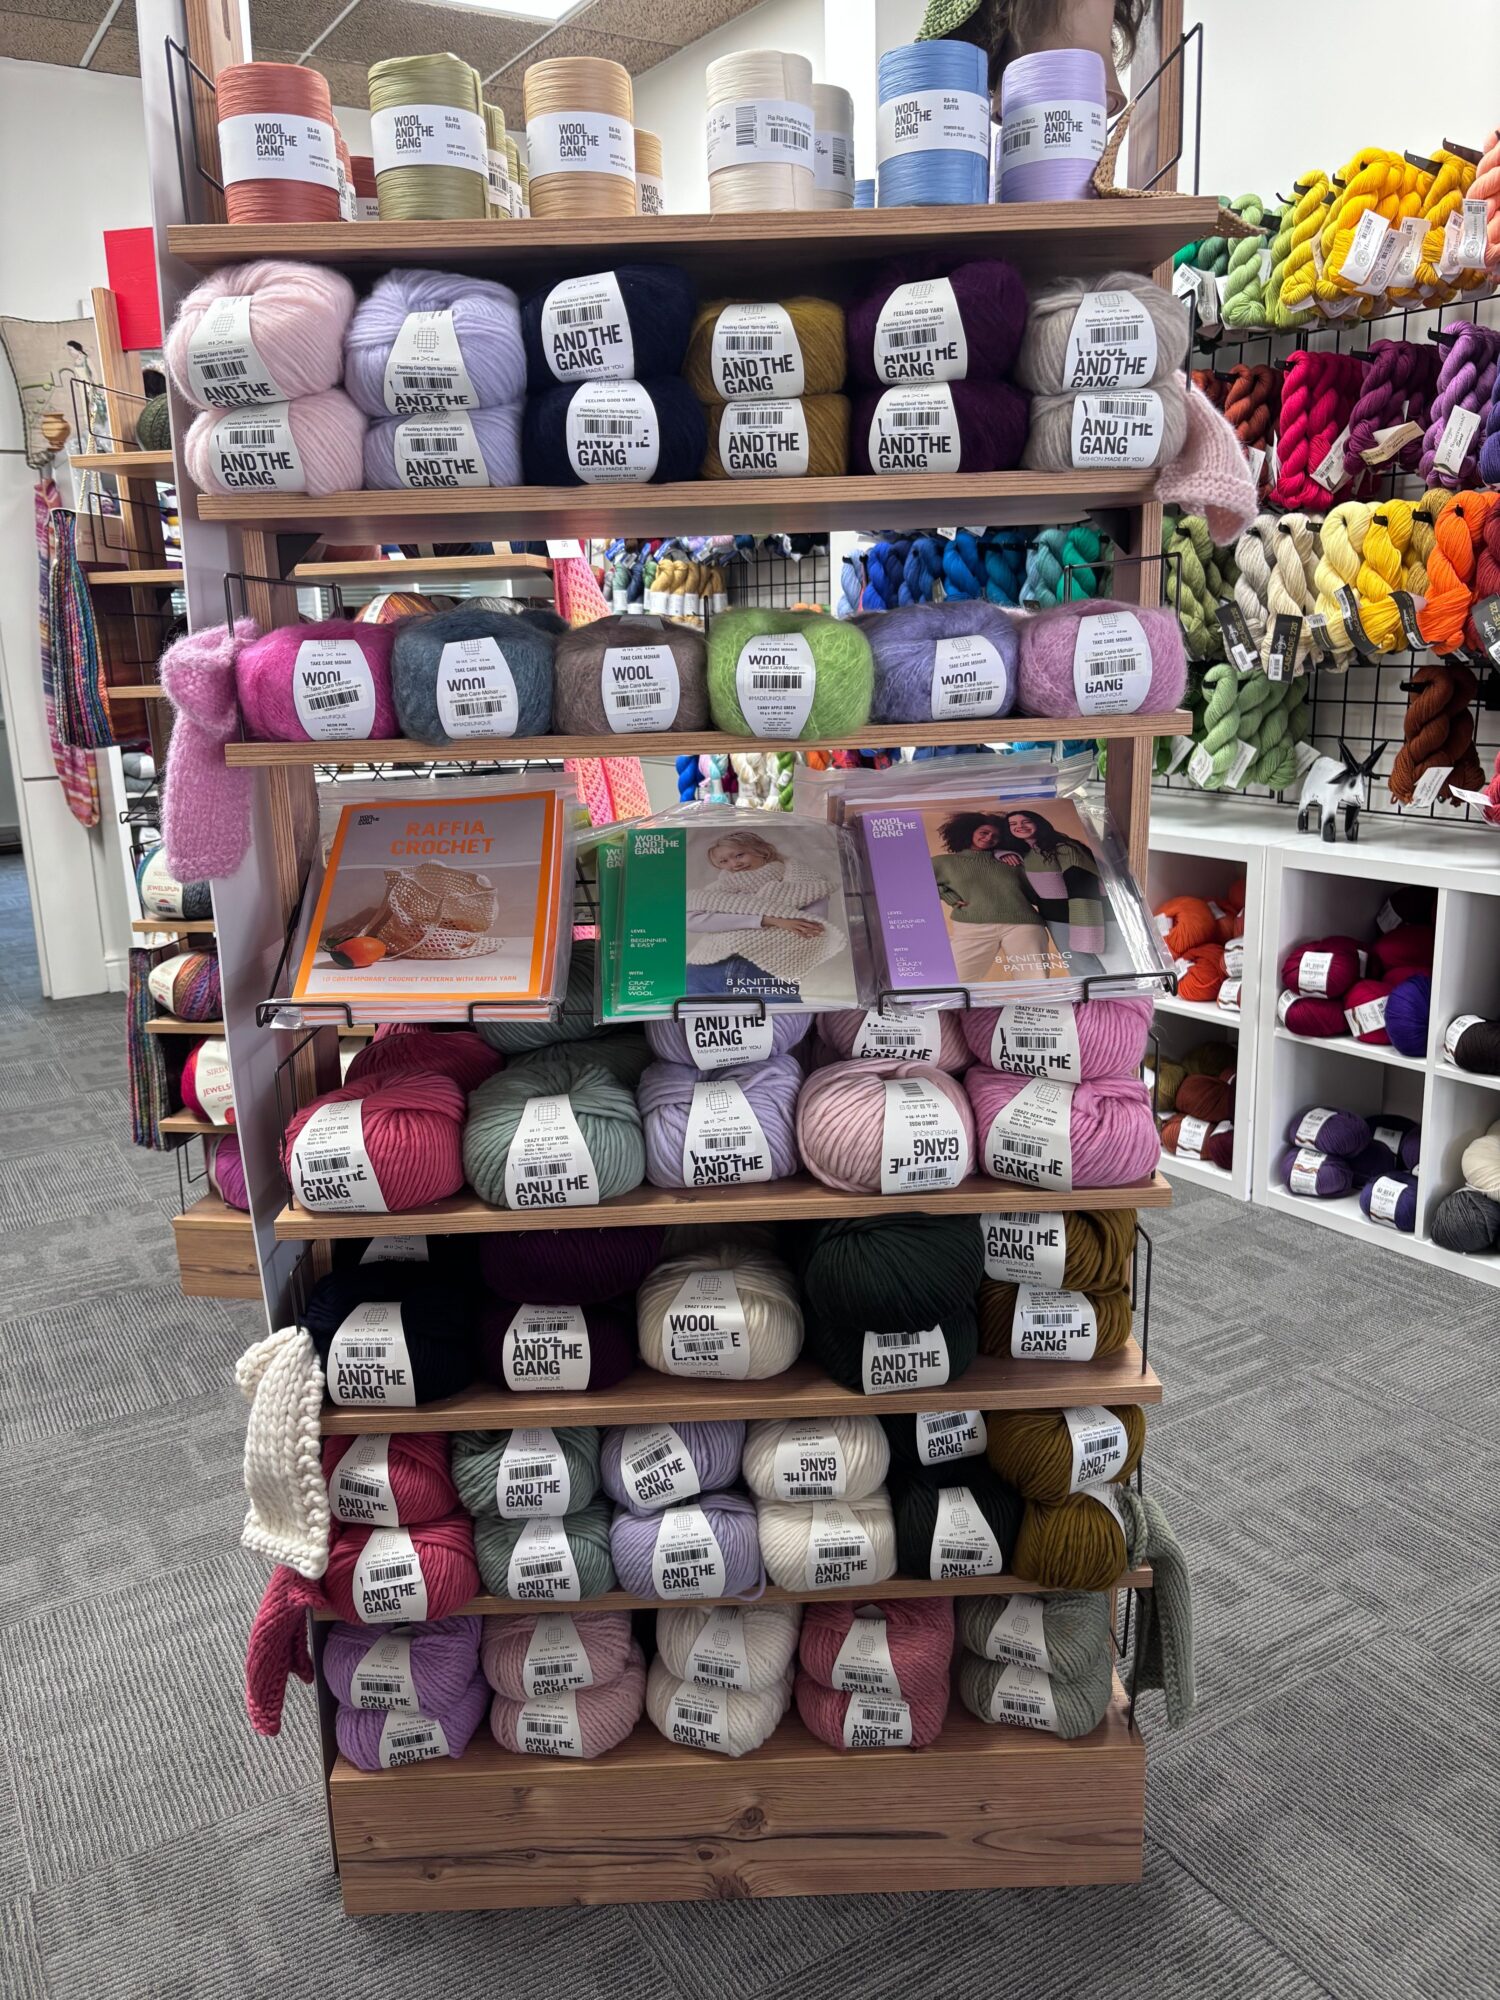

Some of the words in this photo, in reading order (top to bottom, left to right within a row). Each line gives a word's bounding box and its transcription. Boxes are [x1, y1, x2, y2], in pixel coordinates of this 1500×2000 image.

[895, 100, 920, 116] WOOL
[394, 115, 422, 127] WOOL
[895, 112, 914, 128] AND
[914, 110, 932, 122] THE
[1044, 110, 1072, 122] WOOL
[255, 123, 285, 134] WOOL
[395, 127, 414, 139] AND
[414, 126, 434, 137] THE
[559, 124, 587, 134] WOOL
[895, 126, 918, 138] GANG
[1044, 121, 1066, 133] AND
[1066, 121, 1082, 132] THE
[256, 134, 277, 145] AND
[278, 134, 298, 147] THE
[396, 138, 421, 150] GANG
[560, 134, 580, 146] AND
[580, 134, 599, 146] THE
[1044, 131, 1070, 143] GANG
[256, 145, 284, 156] GANG
[560, 146, 586, 157] GANG
[554, 328, 587, 354] AND
[588, 324, 623, 344] THE
[556, 347, 603, 371] GANG
[1074, 359, 1115, 376] AND
[1116, 357, 1147, 375] THE
[722, 360, 758, 381] AND
[760, 354, 795, 374] THE
[725, 376, 773, 394] GANG
[1071, 377, 1119, 388] GANG
[728, 434, 764, 454] AND
[766, 433, 800, 452] THE
[878, 437, 915, 454] AND
[918, 436, 951, 453] THE
[220, 452, 255, 472] AND
[256, 452, 294, 470] THE
[406, 460, 441, 476] AND
[442, 459, 478, 474] THE
[730, 453, 777, 470] GANG
[879, 454, 928, 469] GANG
[225, 471, 276, 486] GANG
[409, 475, 458, 487] GANG
[1284, 635, 1296, 672] CASCADE
[612, 666, 654, 681] WOOL
[1085, 678, 1123, 694] GANG
[406, 820, 485, 836] RAFFIA
[895, 822, 917, 830] THE
[635, 834, 665, 842] WOOL
[873, 830, 903, 838] GANG
[390, 838, 495, 856] CROCHET
[660, 840, 679, 848] THE
[995, 955, 1002, 963] 8
[1006, 952, 1072, 961] KNITTING
[1004, 961, 1069, 972] PATTERNS
[696, 1029, 742, 1048] GANG
[913, 1137, 958, 1156] GANG
[693, 1163, 729, 1179] AND
[732, 1156, 763, 1172] THE
[517, 1192, 567, 1206] GANG
[987, 1242, 1034, 1261] GANG
[670, 1315, 720, 1331] WOOL
[512, 1344, 547, 1361] AND
[550, 1344, 583, 1359] THE
[514, 1361, 560, 1376] GANG
[871, 1354, 906, 1372] AND
[908, 1351, 941, 1367] THE
[337, 1370, 371, 1385] AND
[372, 1370, 406, 1385] THE
[871, 1369, 918, 1385] GANG
[339, 1386, 386, 1399] GANG
[928, 1434, 953, 1449] AND
[954, 1427, 979, 1442] THE
[929, 1443, 963, 1458] GANG
[800, 1457, 836, 1472] GANG
[1080, 1457, 1101, 1474] AND
[1103, 1450, 1120, 1464] THE
[634, 1471, 660, 1490] AND
[659, 1458, 686, 1478] THE
[1078, 1465, 1106, 1482] GANG
[506, 1482, 533, 1496] AND
[536, 1480, 560, 1494] THE
[638, 1479, 674, 1500] GANG
[506, 1494, 543, 1507] GANG
[662, 1566, 690, 1580] AND
[690, 1563, 716, 1576] THE
[664, 1577, 699, 1590] GANG
[673, 1724, 697, 1738] AND
[698, 1729, 721, 1744] THE
[852, 1729, 879, 1740] AND
[880, 1729, 903, 1739] THE
[389, 1750, 416, 1761] AND
[416, 1746, 440, 1756] THE
